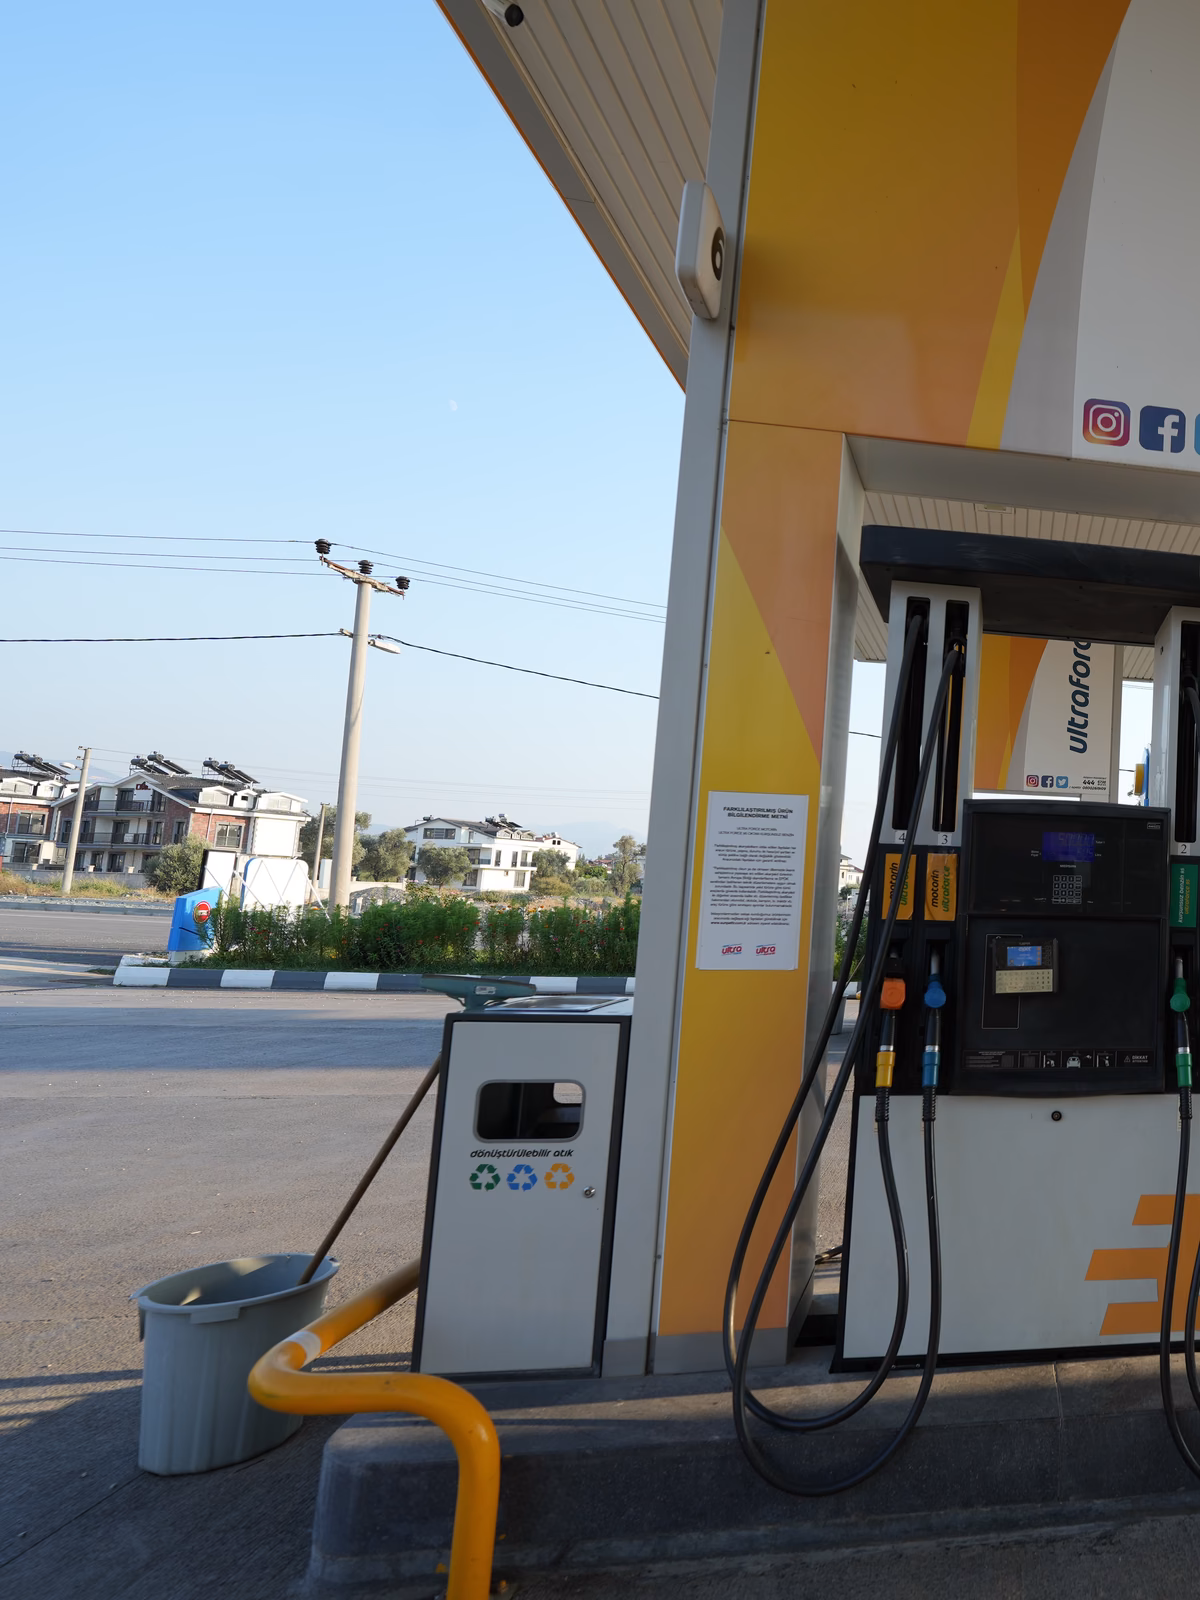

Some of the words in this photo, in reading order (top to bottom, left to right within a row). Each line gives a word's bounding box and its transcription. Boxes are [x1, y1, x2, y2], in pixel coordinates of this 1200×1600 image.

[898, 832, 906, 843] 4
[941, 834, 948, 845] 3
[1180, 844, 1187, 854] 2
[931, 870, 939, 908] motorin
[942, 865, 951, 912] ultraforce
[470, 1149, 551, 1160] dönüştürülebilir
[553, 1149, 574, 1158] atık
